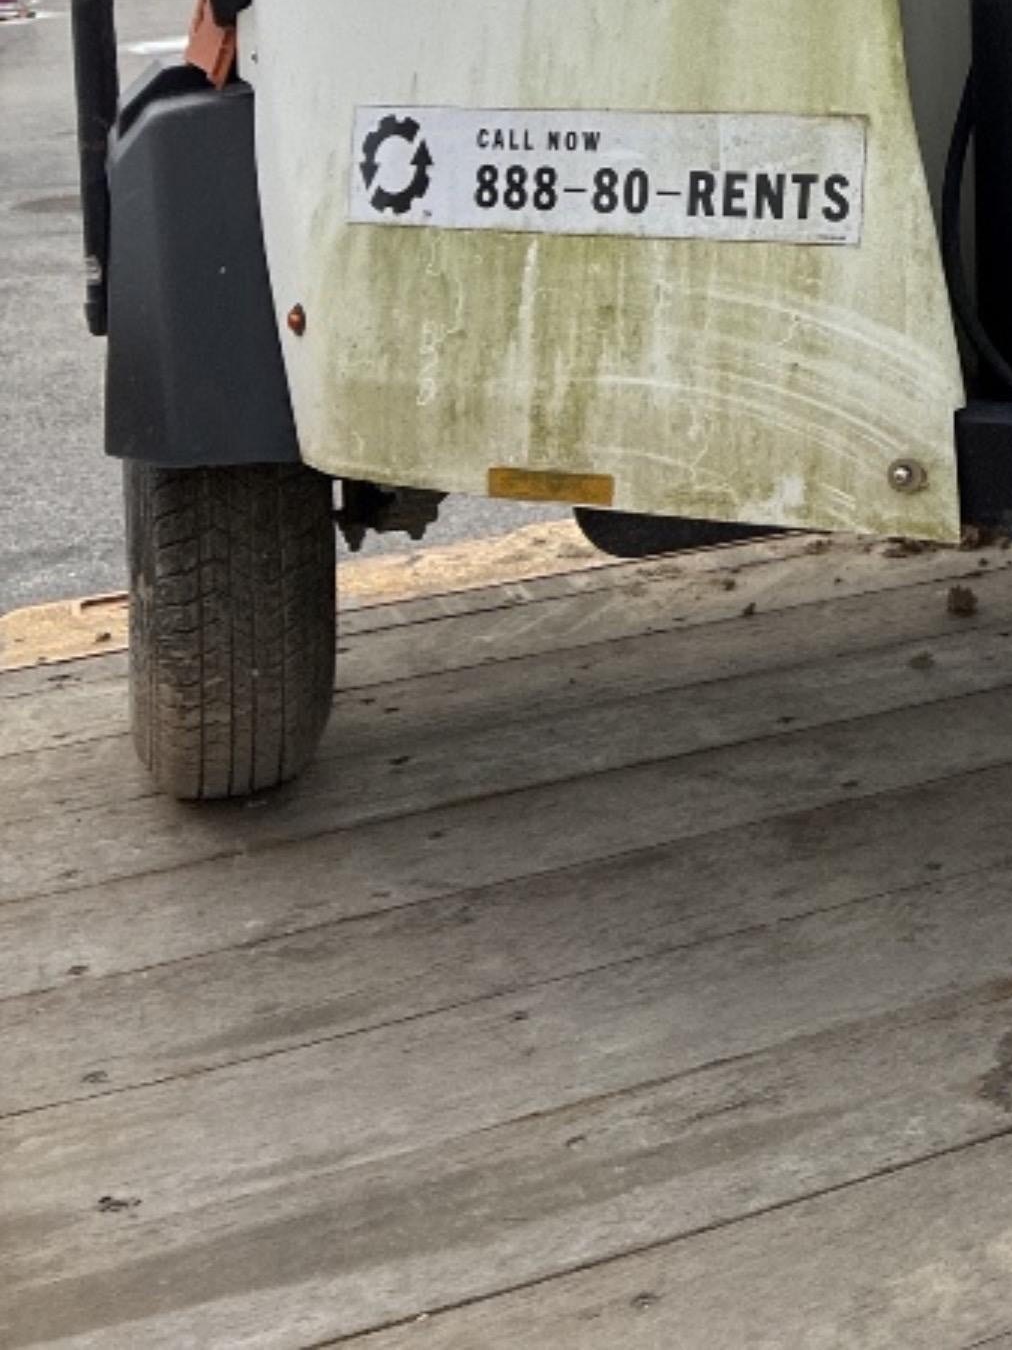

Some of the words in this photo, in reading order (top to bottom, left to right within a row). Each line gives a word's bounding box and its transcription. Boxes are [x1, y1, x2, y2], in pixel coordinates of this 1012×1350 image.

[476, 128, 535, 150] CALL
[547, 130, 601, 151] NOW
[474, 163, 850, 223] 888-80-RENTS
